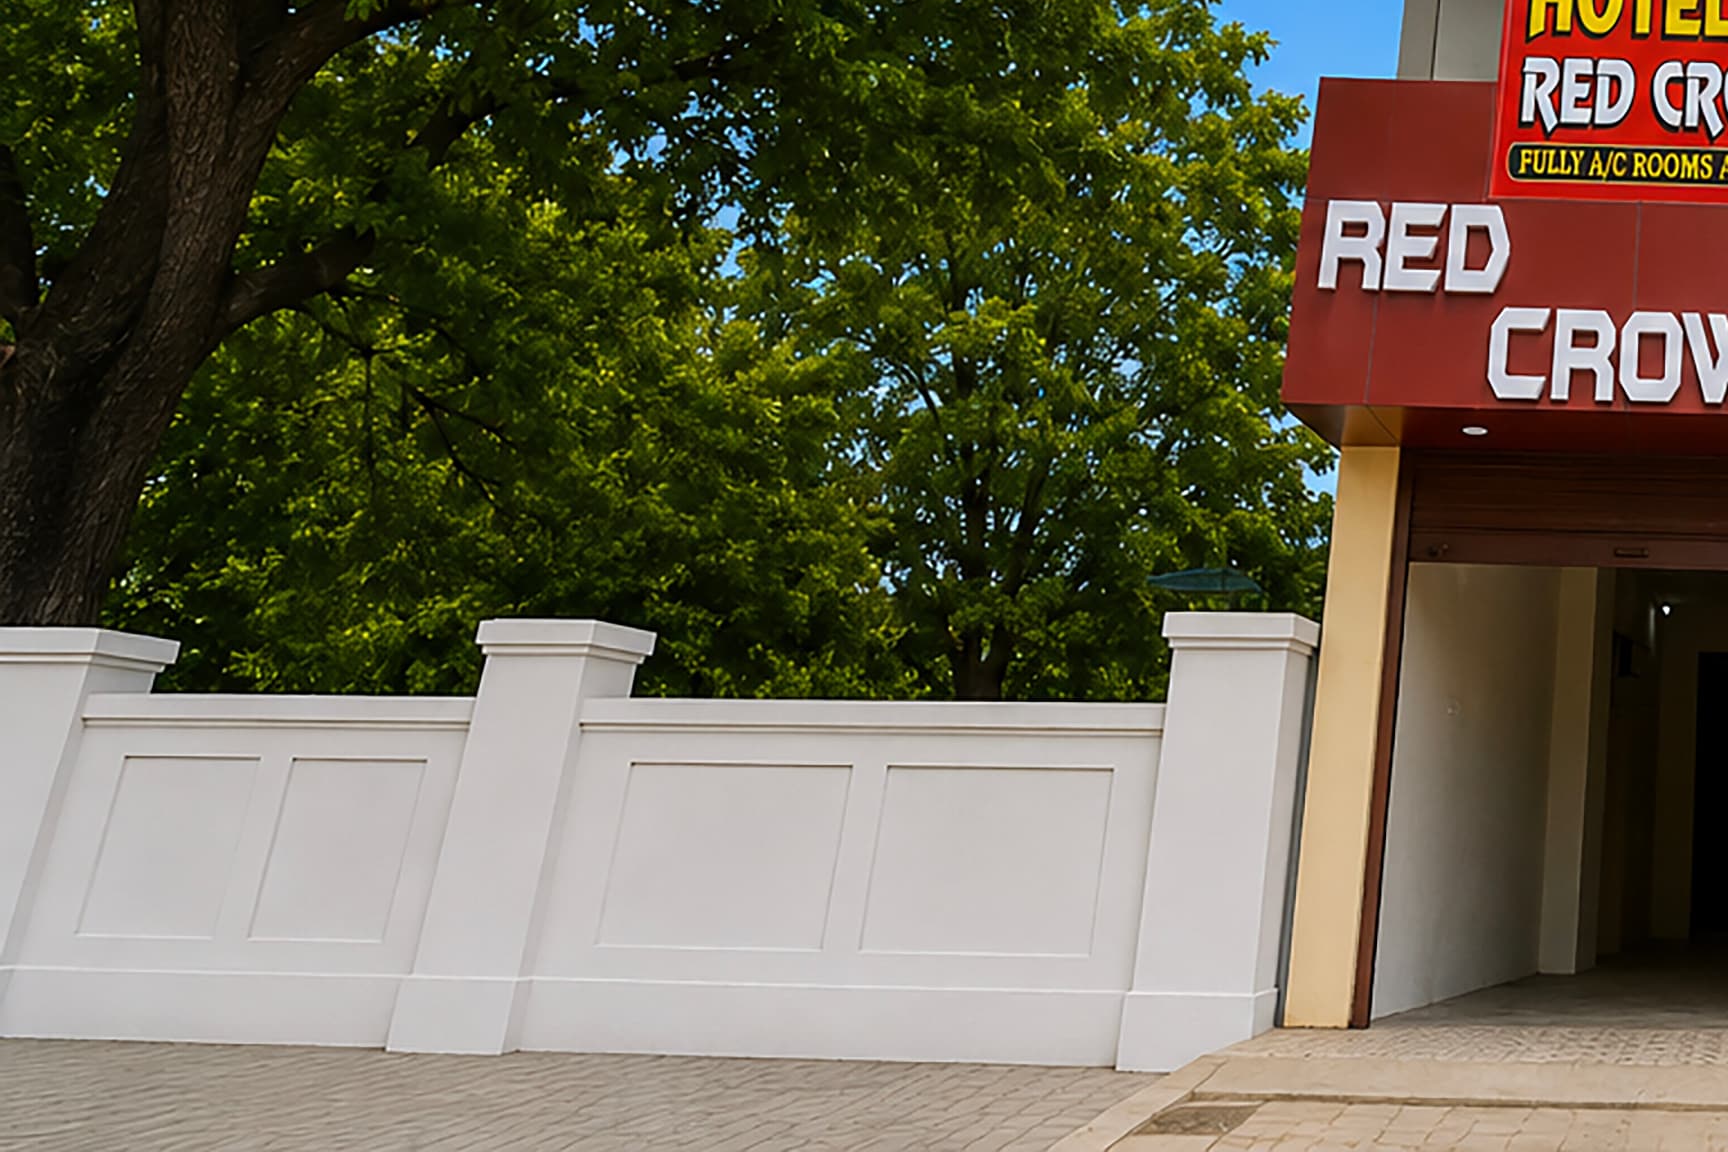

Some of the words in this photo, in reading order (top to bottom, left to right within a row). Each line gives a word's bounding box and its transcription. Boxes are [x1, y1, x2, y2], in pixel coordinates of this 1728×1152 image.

[1519, 56, 1636, 136] RED
[1518, 148, 1586, 176] FULLY
[1588, 151, 1628, 181] A/C
[1633, 154, 1713, 180] ROOMS
[1317, 199, 1511, 294] RED
